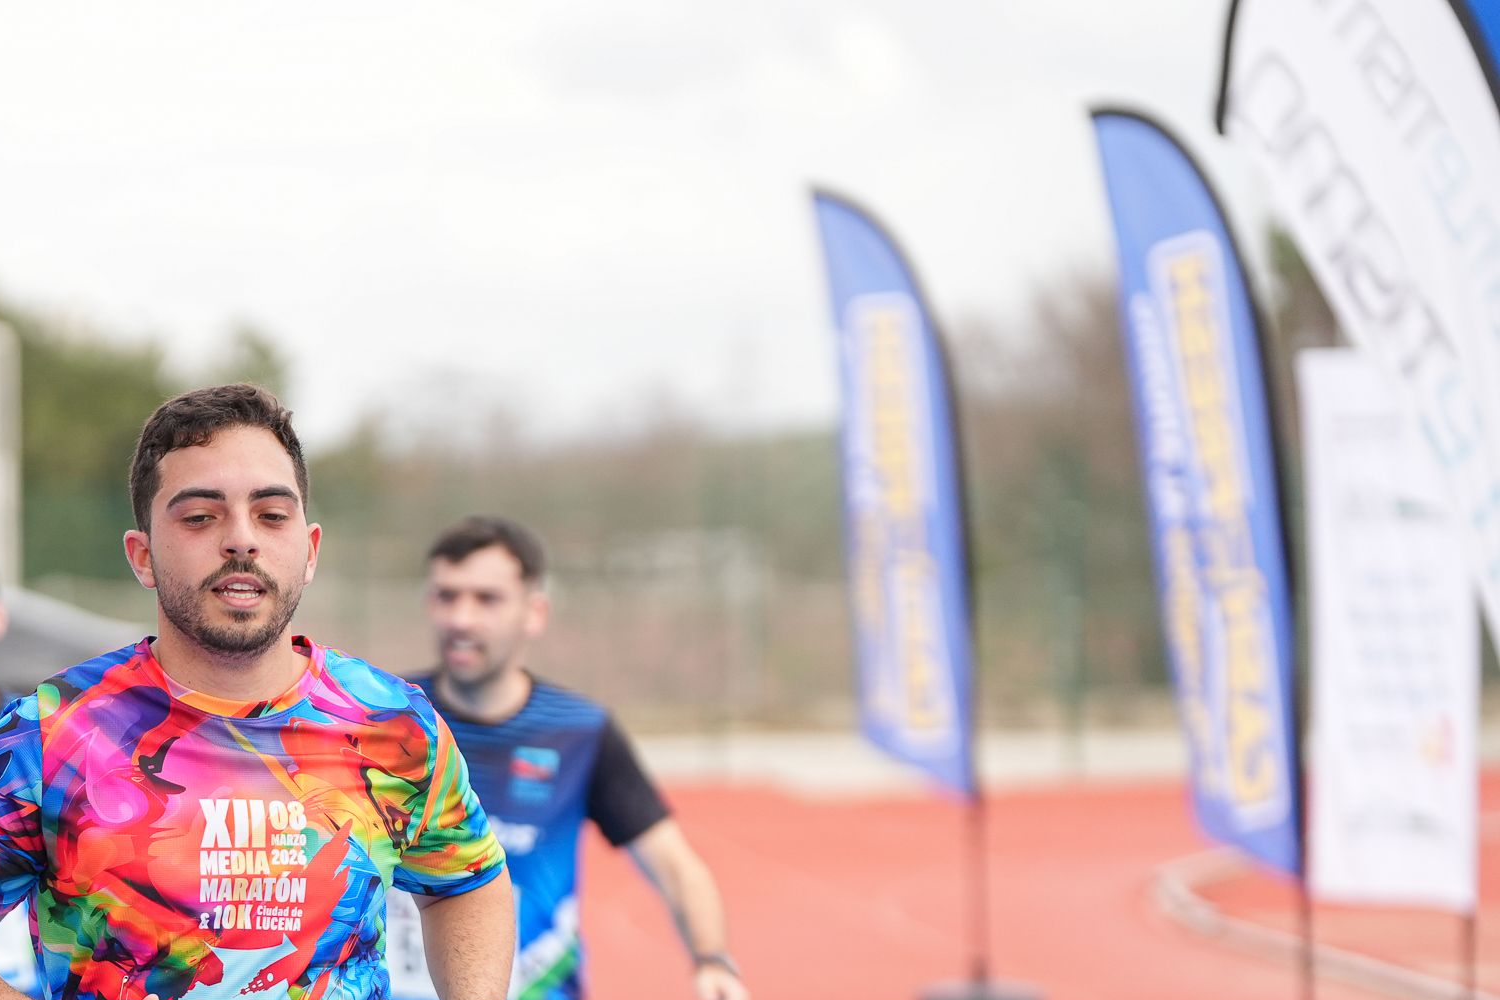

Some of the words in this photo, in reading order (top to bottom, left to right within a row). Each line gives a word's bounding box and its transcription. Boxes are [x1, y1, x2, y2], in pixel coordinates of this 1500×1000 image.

[199, 799, 266, 848] XII
[269, 800, 307, 831] 08
[271, 833, 307, 846] MARZO
[200, 850, 270, 875] MEDIA
[271, 849, 308, 865] 2026
[200, 871, 307, 903] MARATÓN
[199, 912, 210, 930] &
[213, 904, 253, 930] 10K
[256, 916, 301, 931] LUCENA
[257, 905, 290, 917] Ciudad
[291, 906, 303, 917] de
